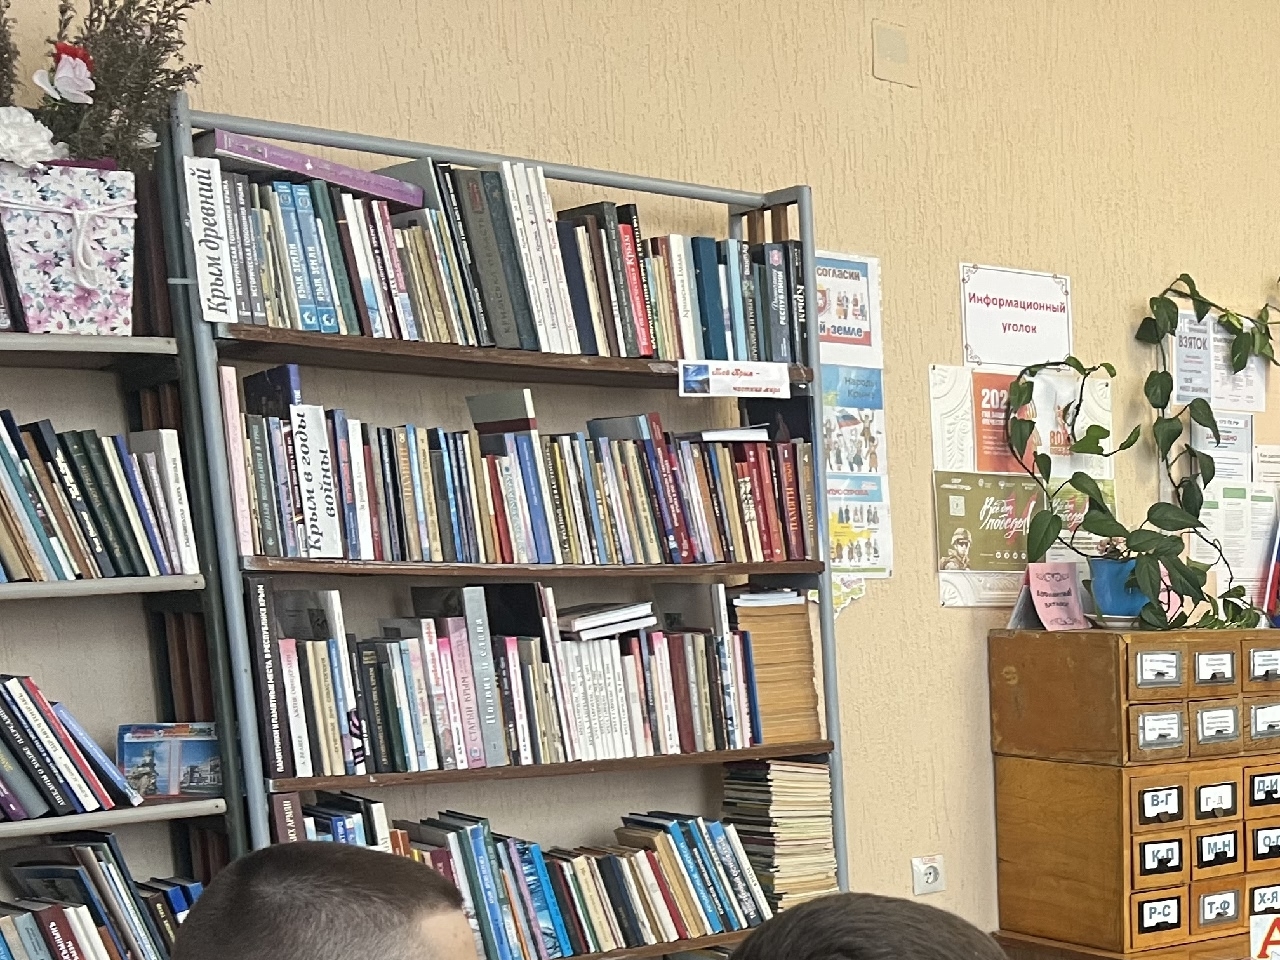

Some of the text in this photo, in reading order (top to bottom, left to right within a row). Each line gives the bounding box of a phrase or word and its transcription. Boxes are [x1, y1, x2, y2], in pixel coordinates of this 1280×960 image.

[189, 167, 229, 315] Крым древний
[625, 235, 635, 266] Крым
[816, 266, 861, 281] согласии
[968, 291, 1066, 315] Информационный
[830, 325, 863, 338] земле
[1001, 321, 1037, 336] уголок
[1178, 335, 1208, 350] ВЗЯТОК
[981, 388, 1009, 409] 202
[295, 412, 323, 552] Крым в годы
[319, 449, 336, 518] войны
[785, 487, 798, 530] ПАМЯТИ
[461, 676, 474, 704] КРЫМ
[485, 673, 496, 724] Подвиг
[272, 730, 285, 773] ПАМЯТНИКИ
[1151, 793, 1172, 808] В-Г
[1207, 838, 1231, 856] М-Н
[1207, 898, 1230, 915] Т-Ф
[1257, 890, 1279, 905] Х-Я
[1148, 903, 1171, 920] Р-С
